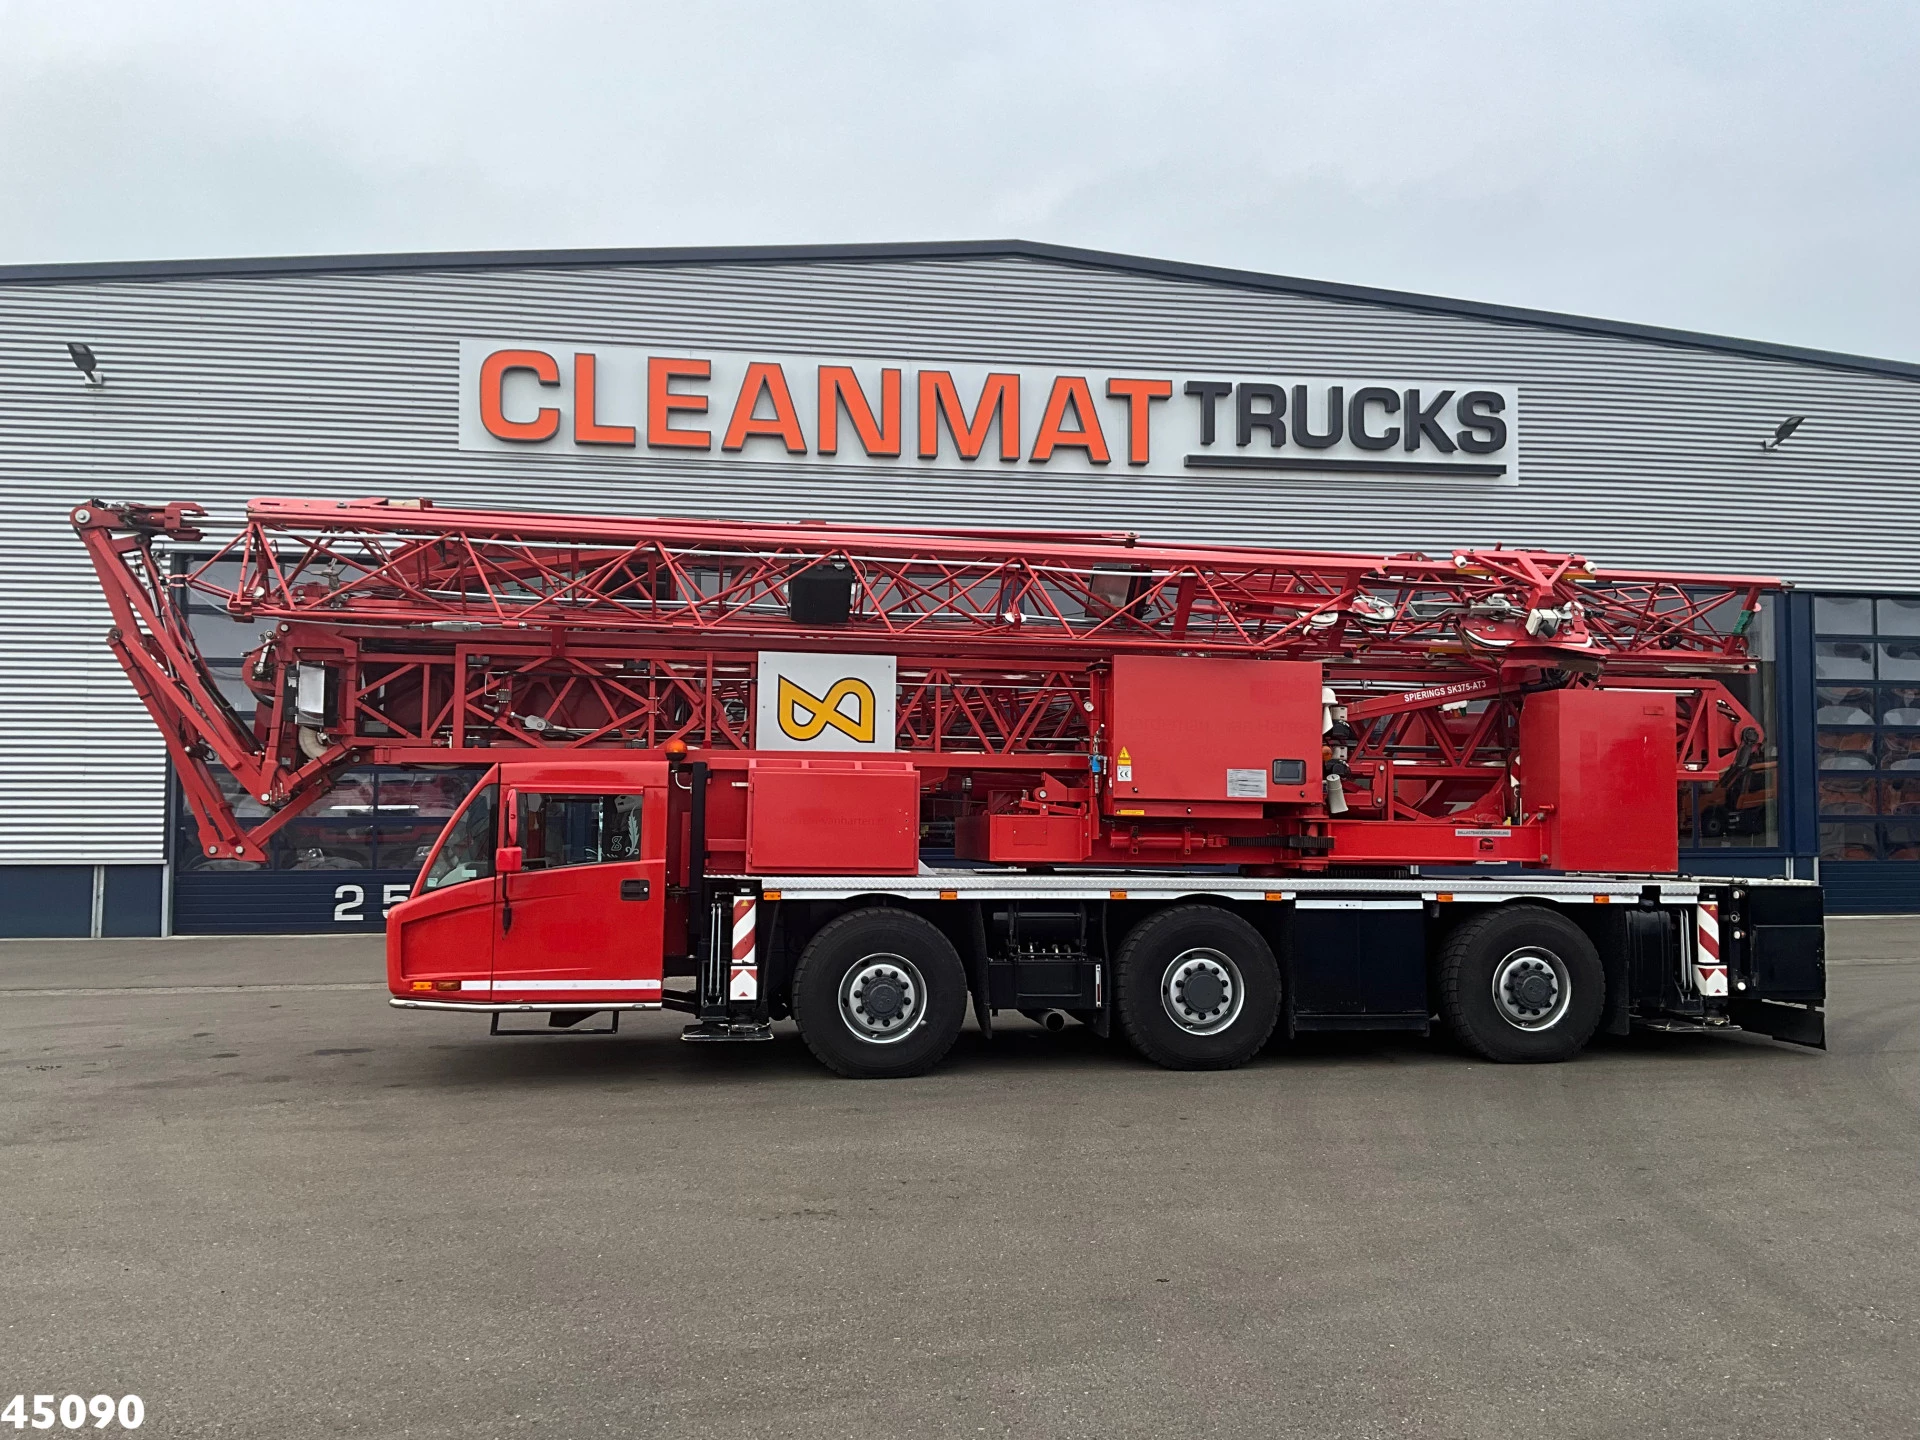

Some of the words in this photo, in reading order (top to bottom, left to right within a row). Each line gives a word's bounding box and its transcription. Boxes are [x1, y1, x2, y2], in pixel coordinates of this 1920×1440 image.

[479, 348, 1172, 466] CLEANMAT
[1184, 380, 1508, 454] TRUCKS
[1404, 687, 1446, 702] SPIERINGS
[1447, 679, 1487, 694] SK375-AT3
